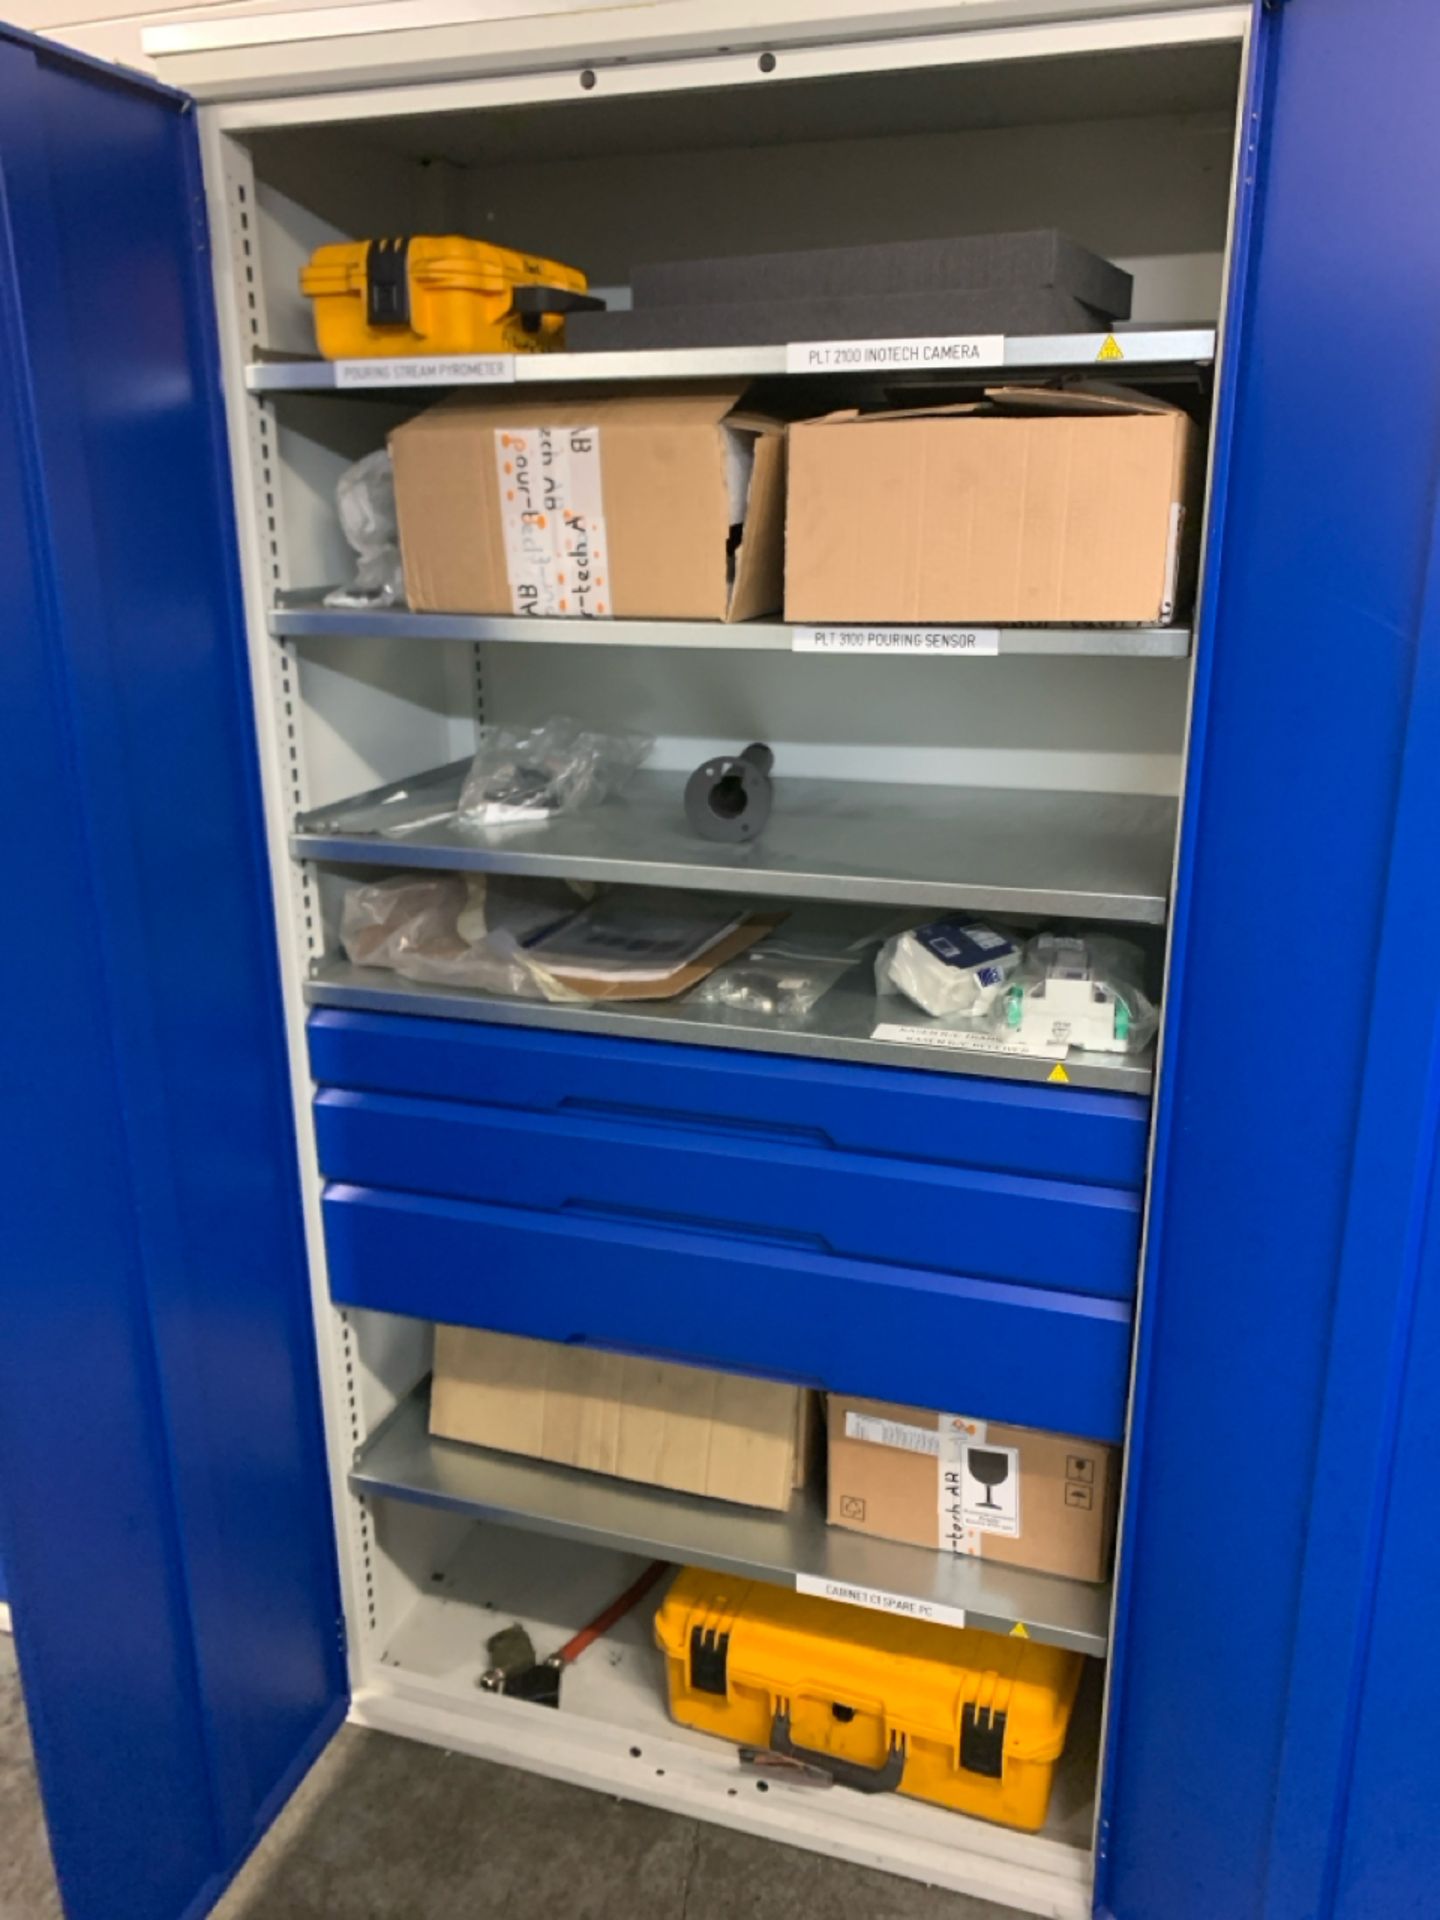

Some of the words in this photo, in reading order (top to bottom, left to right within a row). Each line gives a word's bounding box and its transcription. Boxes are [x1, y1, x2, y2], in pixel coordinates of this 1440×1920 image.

[808, 350, 830, 365] PLT
[834, 349, 861, 364] 2100
[864, 346, 919, 362] INOTECH
[923, 344, 980, 360] CAMERA
[344, 366, 390, 380] POURING
[393, 364, 437, 378] STREAM
[439, 361, 504, 376] PYROMETER
[815, 632, 835, 647] PLT
[839, 632, 863, 647] 3100
[867, 633, 921, 648] POURING
[925, 634, 976, 649] SENSOR
[826, 1584, 867, 1601] CABINET
[883, 1597, 915, 1612] SPARE
[918, 1605, 932, 1618] PC
